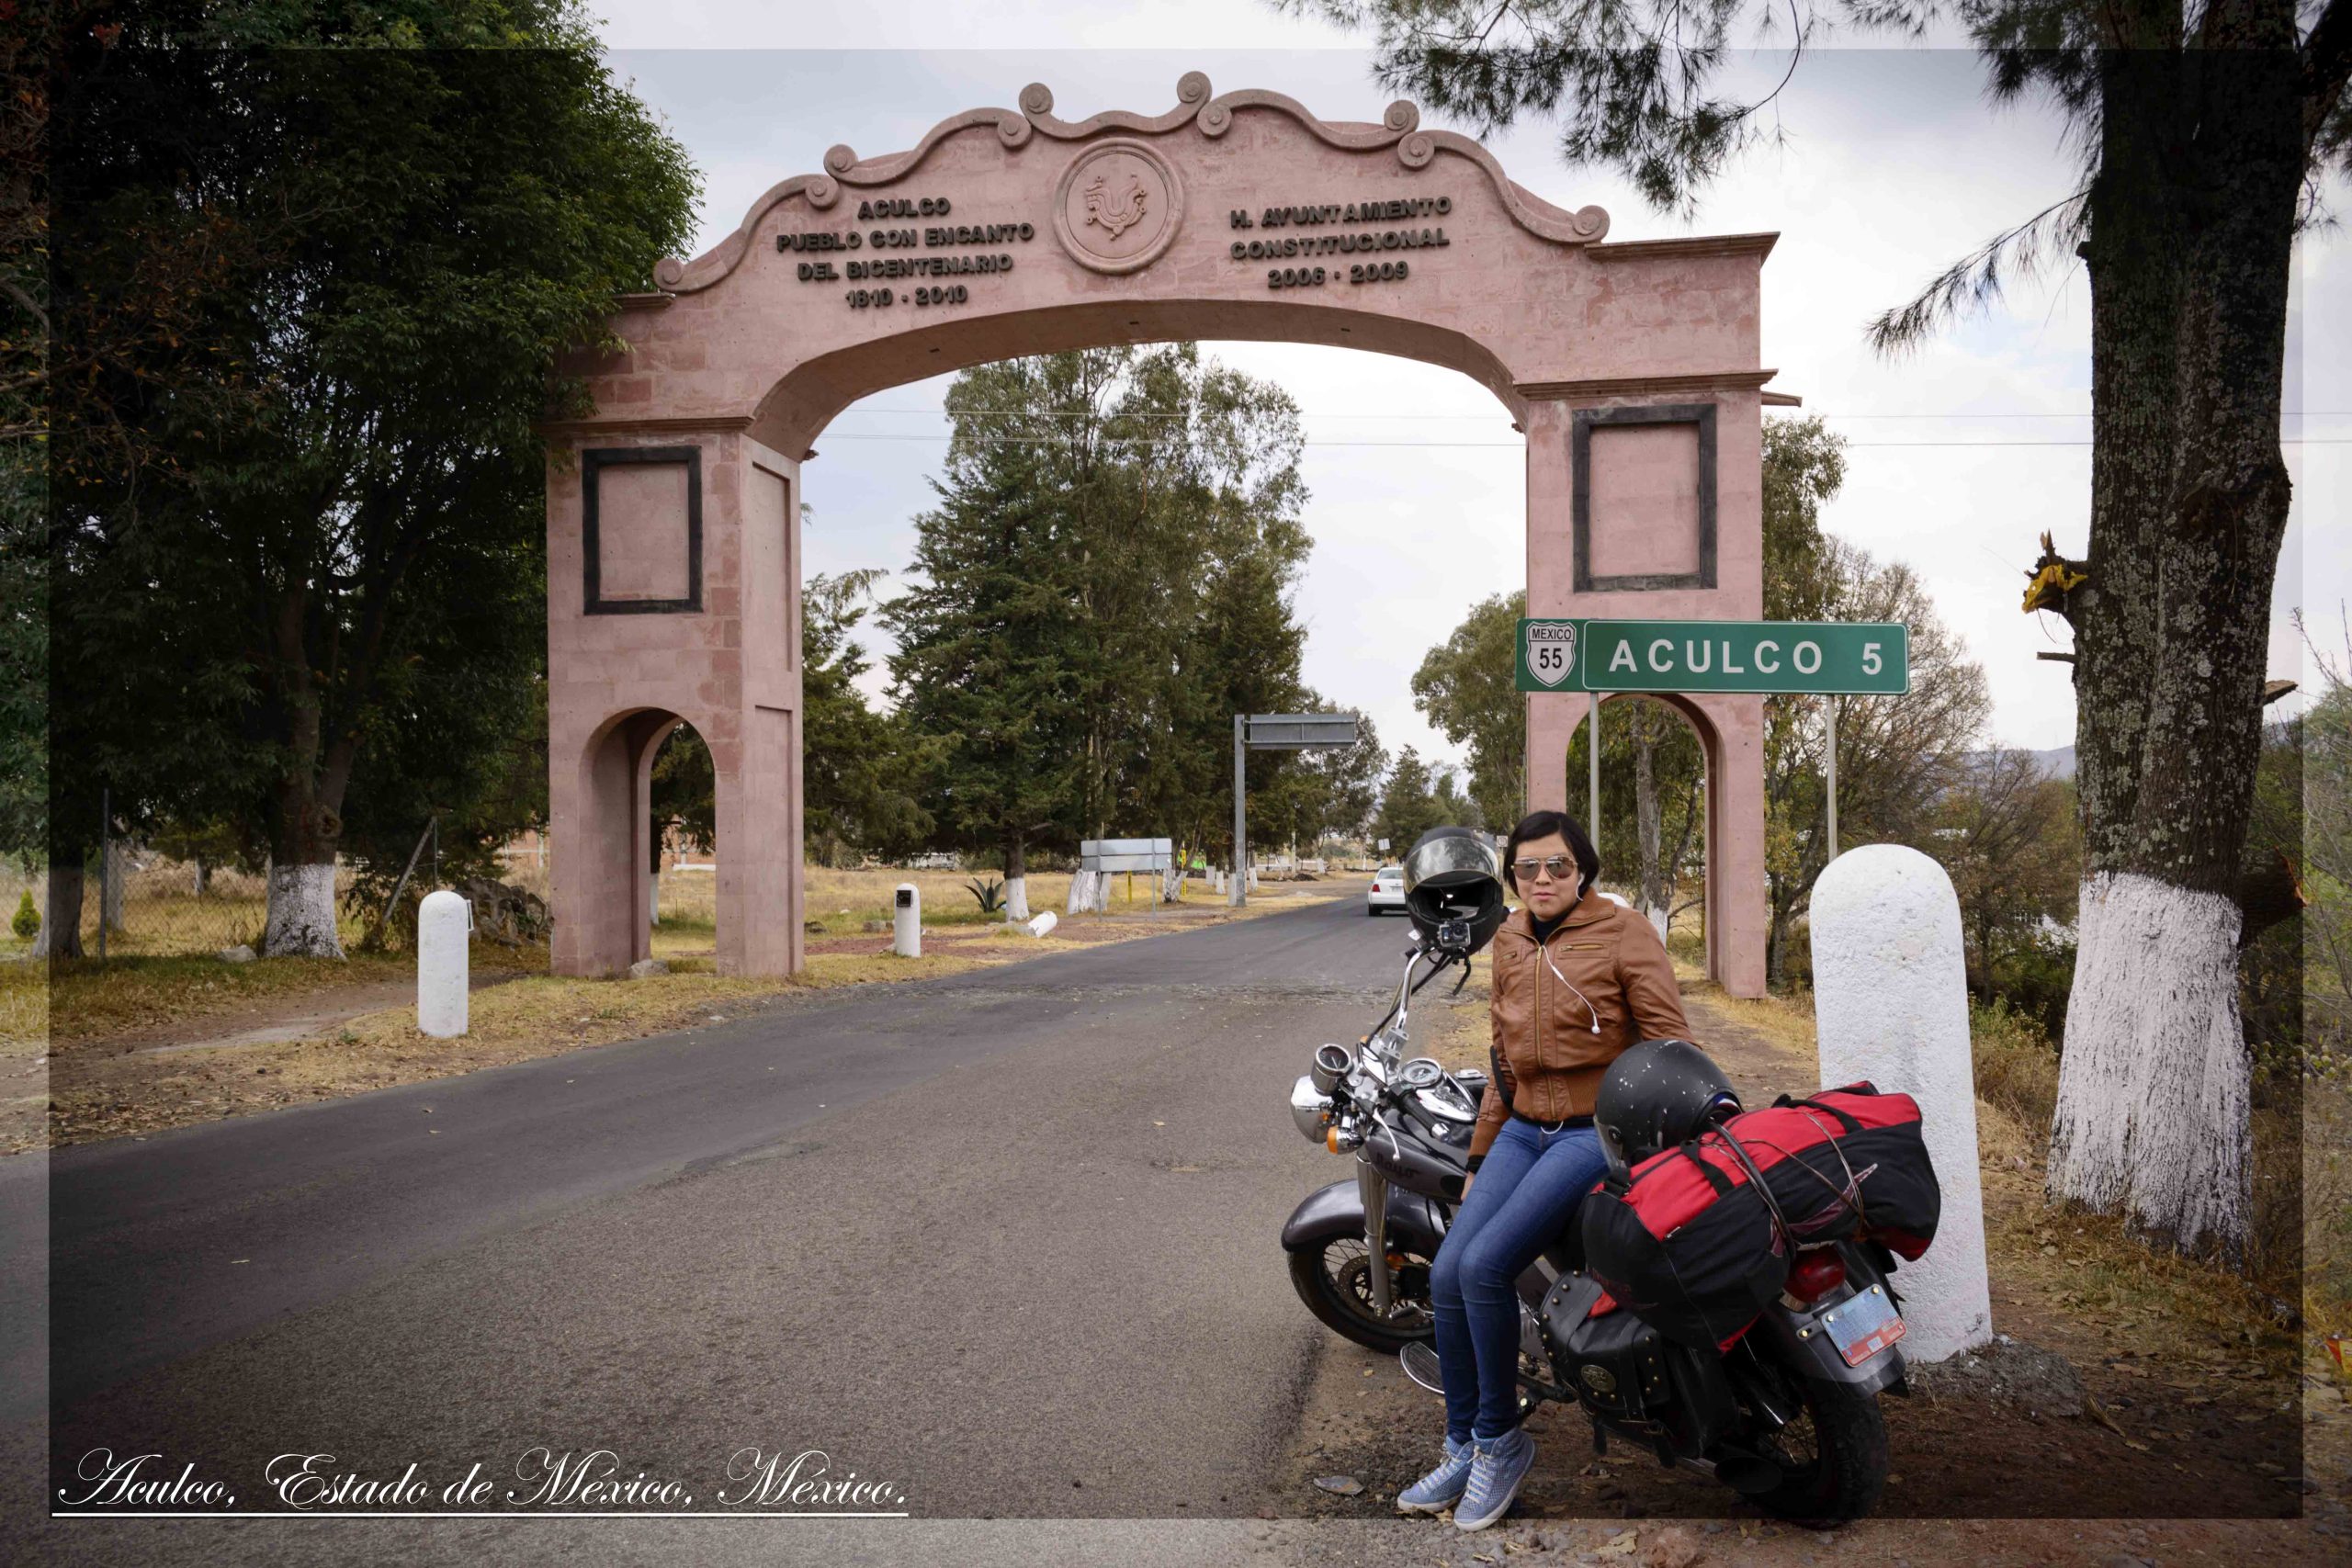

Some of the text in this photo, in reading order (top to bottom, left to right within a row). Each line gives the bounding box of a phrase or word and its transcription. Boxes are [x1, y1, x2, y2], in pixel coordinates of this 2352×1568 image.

[857, 197, 951, 220] ACULCO
[1230, 196, 1453, 228] H. AYUNTAMIENTO
[776, 222, 1035, 254] PUEBLO CON ENCANTO
[1229, 228, 1450, 260] CONSTITUCIONAL
[797, 254, 1013, 281] DEL BICENTENARIO
[1267, 266, 1326, 288] 2006
[1350, 260, 1409, 284] 2009
[844, 288, 894, 309] 1810
[915, 285, 968, 306] 2010
[1532, 627, 1572, 640] MEXICO
[1539, 648, 1562, 669] 55
[1609, 639, 1883, 675] ACULCO 5
